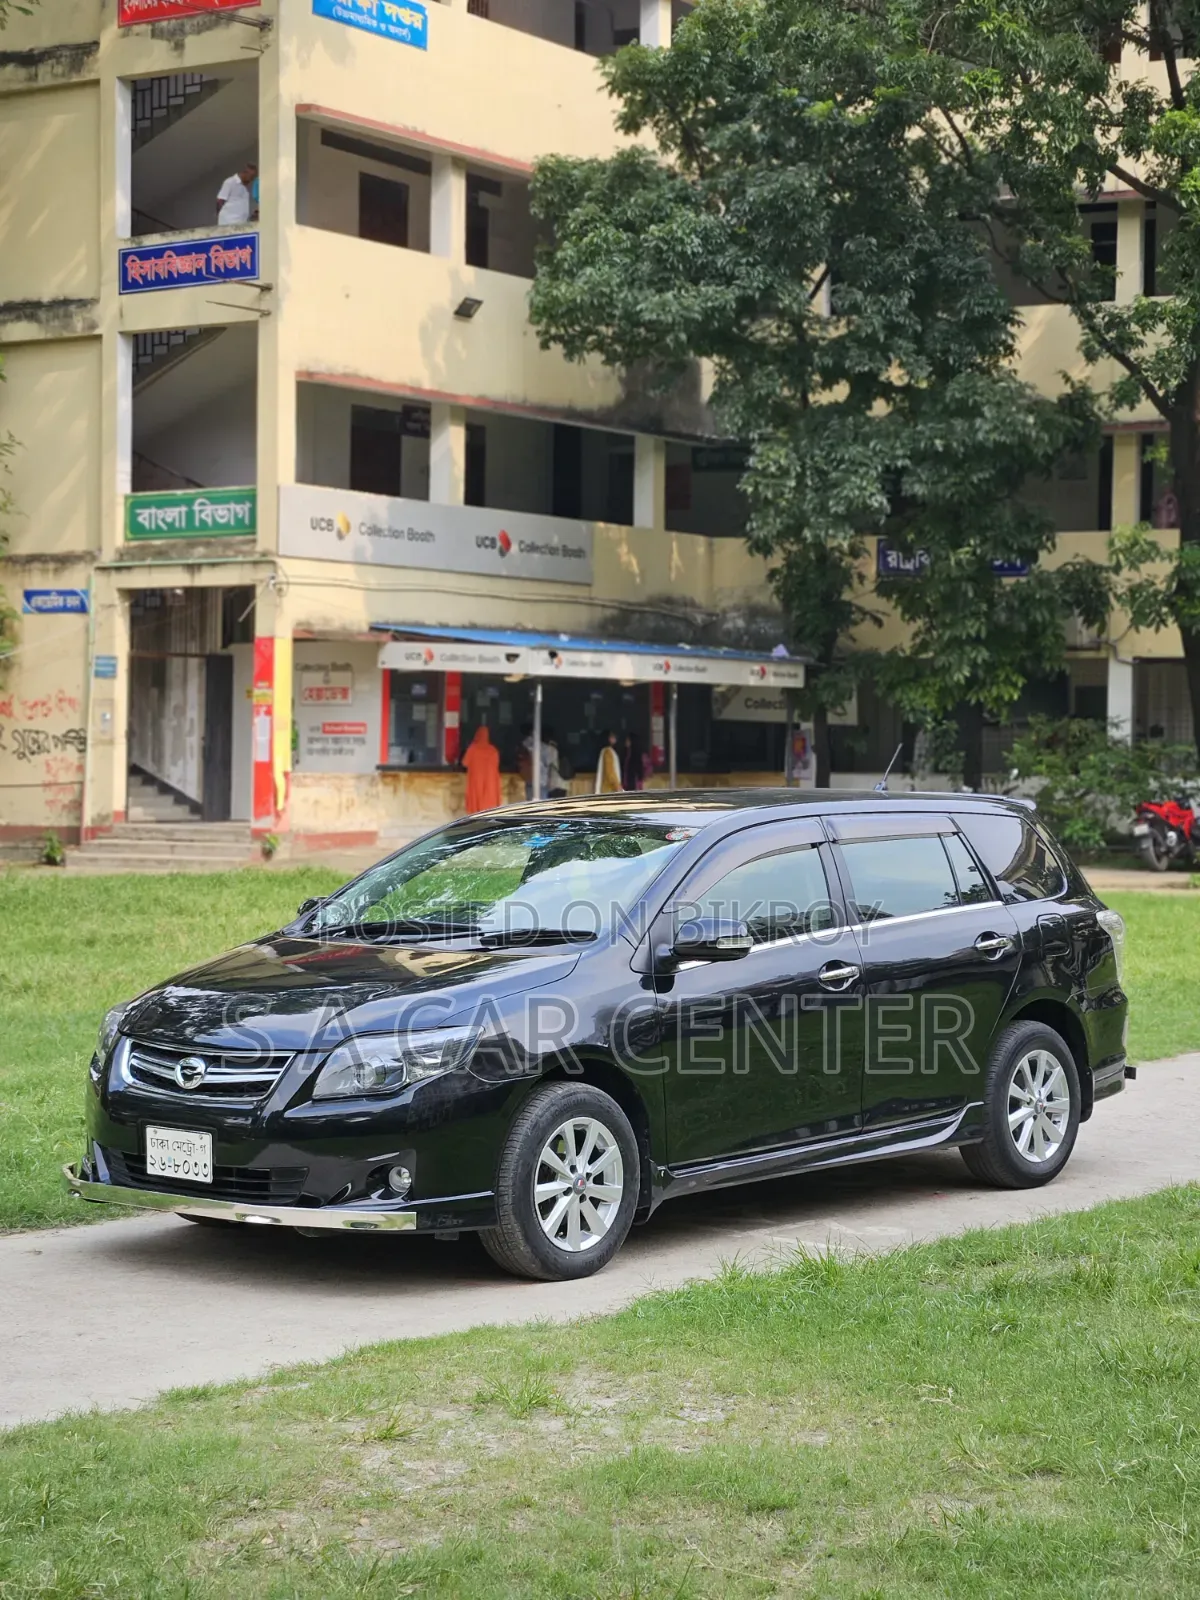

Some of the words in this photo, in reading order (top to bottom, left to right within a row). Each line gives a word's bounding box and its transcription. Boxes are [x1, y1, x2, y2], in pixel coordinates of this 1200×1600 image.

[125, 250, 207, 284] হিসাববিজ্ঞান
[209, 244, 253, 273] বিভাগ
[135, 504, 188, 531] বাংলা
[192, 497, 252, 527] বিভাগ
[310, 516, 334, 531] UCB
[359, 521, 405, 540] Collection
[407, 526, 435, 543] Booth
[475, 535, 497, 550] UCB
[518, 540, 560, 557] Collection
[561, 544, 586, 560] Booth
[150, 1137, 169, 1150] ঢাকা
